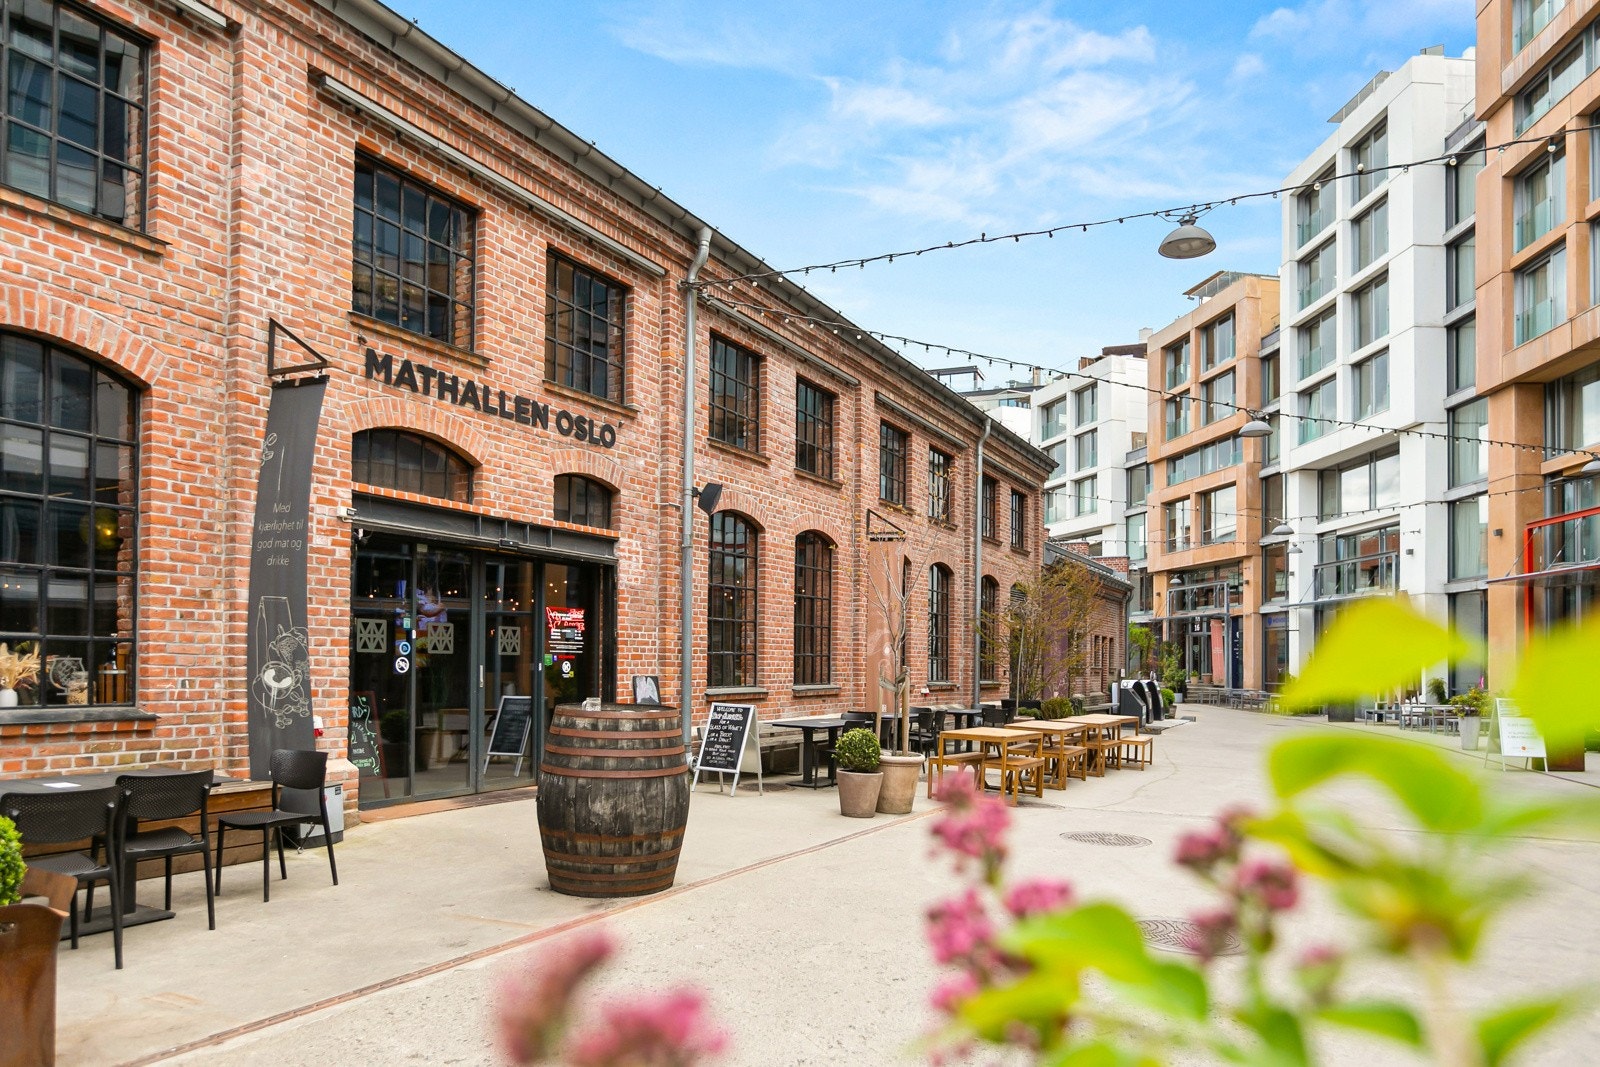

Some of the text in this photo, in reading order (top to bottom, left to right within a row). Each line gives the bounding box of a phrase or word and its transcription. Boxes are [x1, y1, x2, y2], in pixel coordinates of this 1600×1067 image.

[365, 348, 616, 448] MATHALLEN OSLO
[273, 502, 291, 513] Med
[259, 519, 304, 534] kjærlighet til
[257, 538, 302, 551] god mat og
[267, 555, 290, 566] drikke
